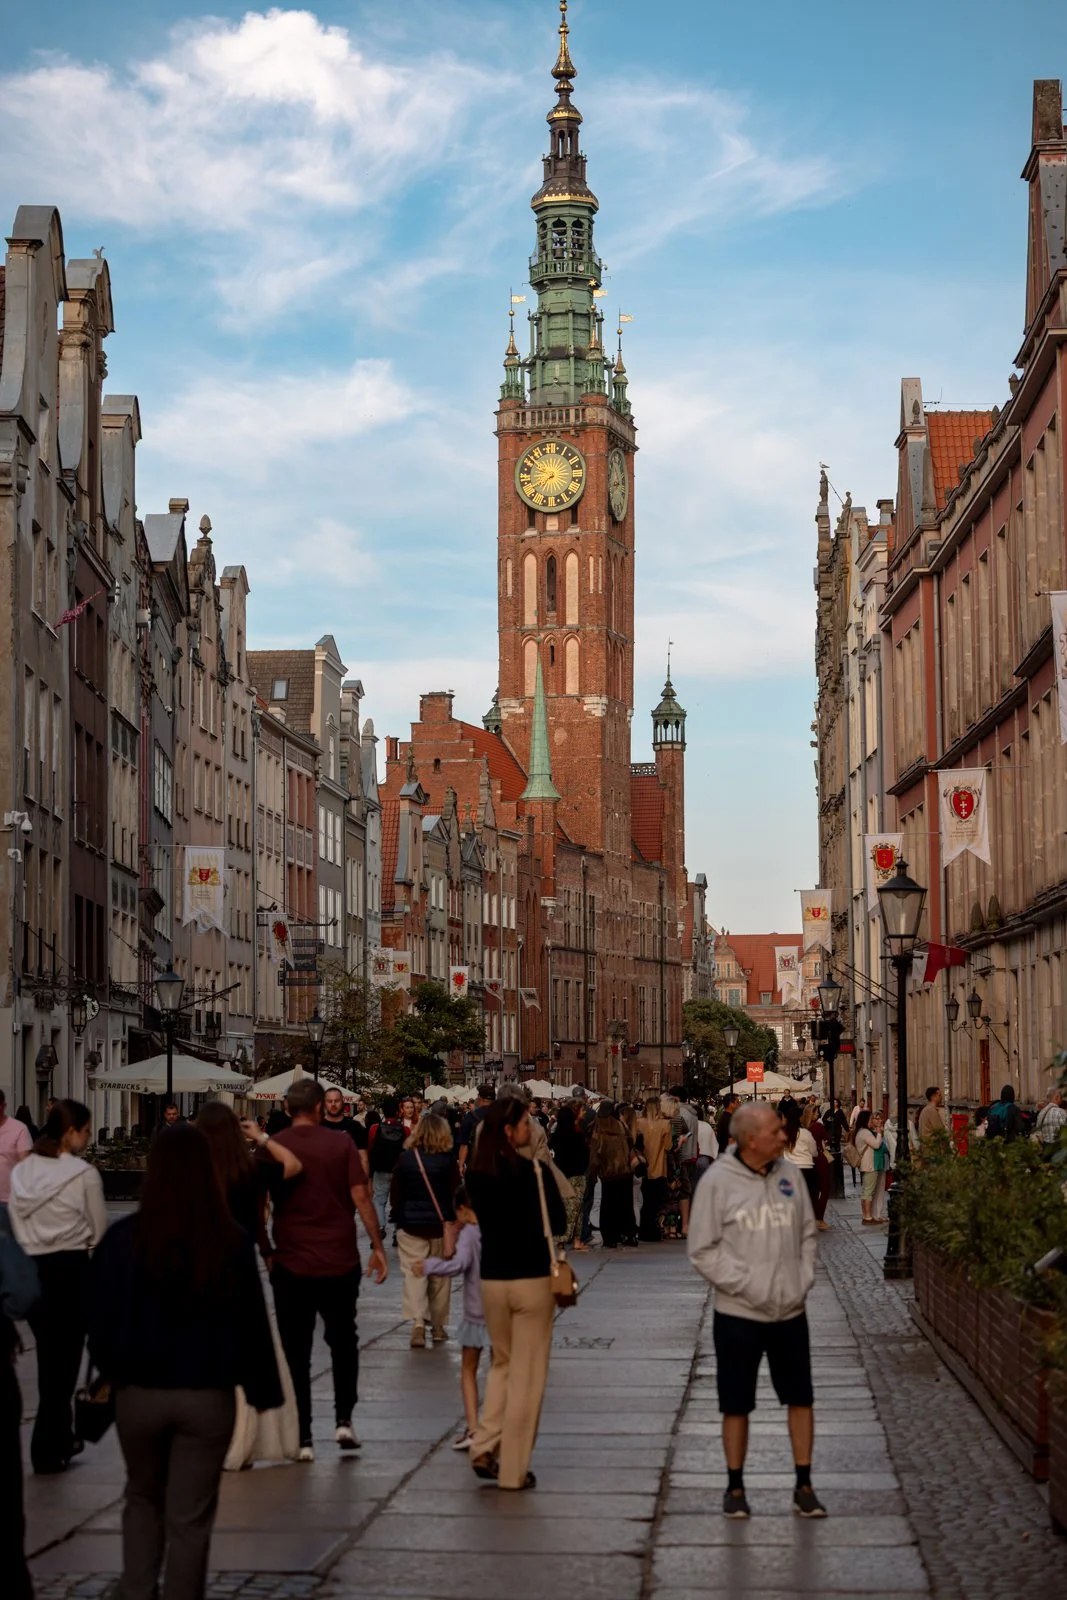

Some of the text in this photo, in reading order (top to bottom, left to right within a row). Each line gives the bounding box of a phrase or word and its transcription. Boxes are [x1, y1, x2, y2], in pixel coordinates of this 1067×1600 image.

[99, 1082, 141, 1091] STARBUCKS
[215, 1083, 246, 1091] STARBUCKS
[735, 1202, 793, 1230] NASA
